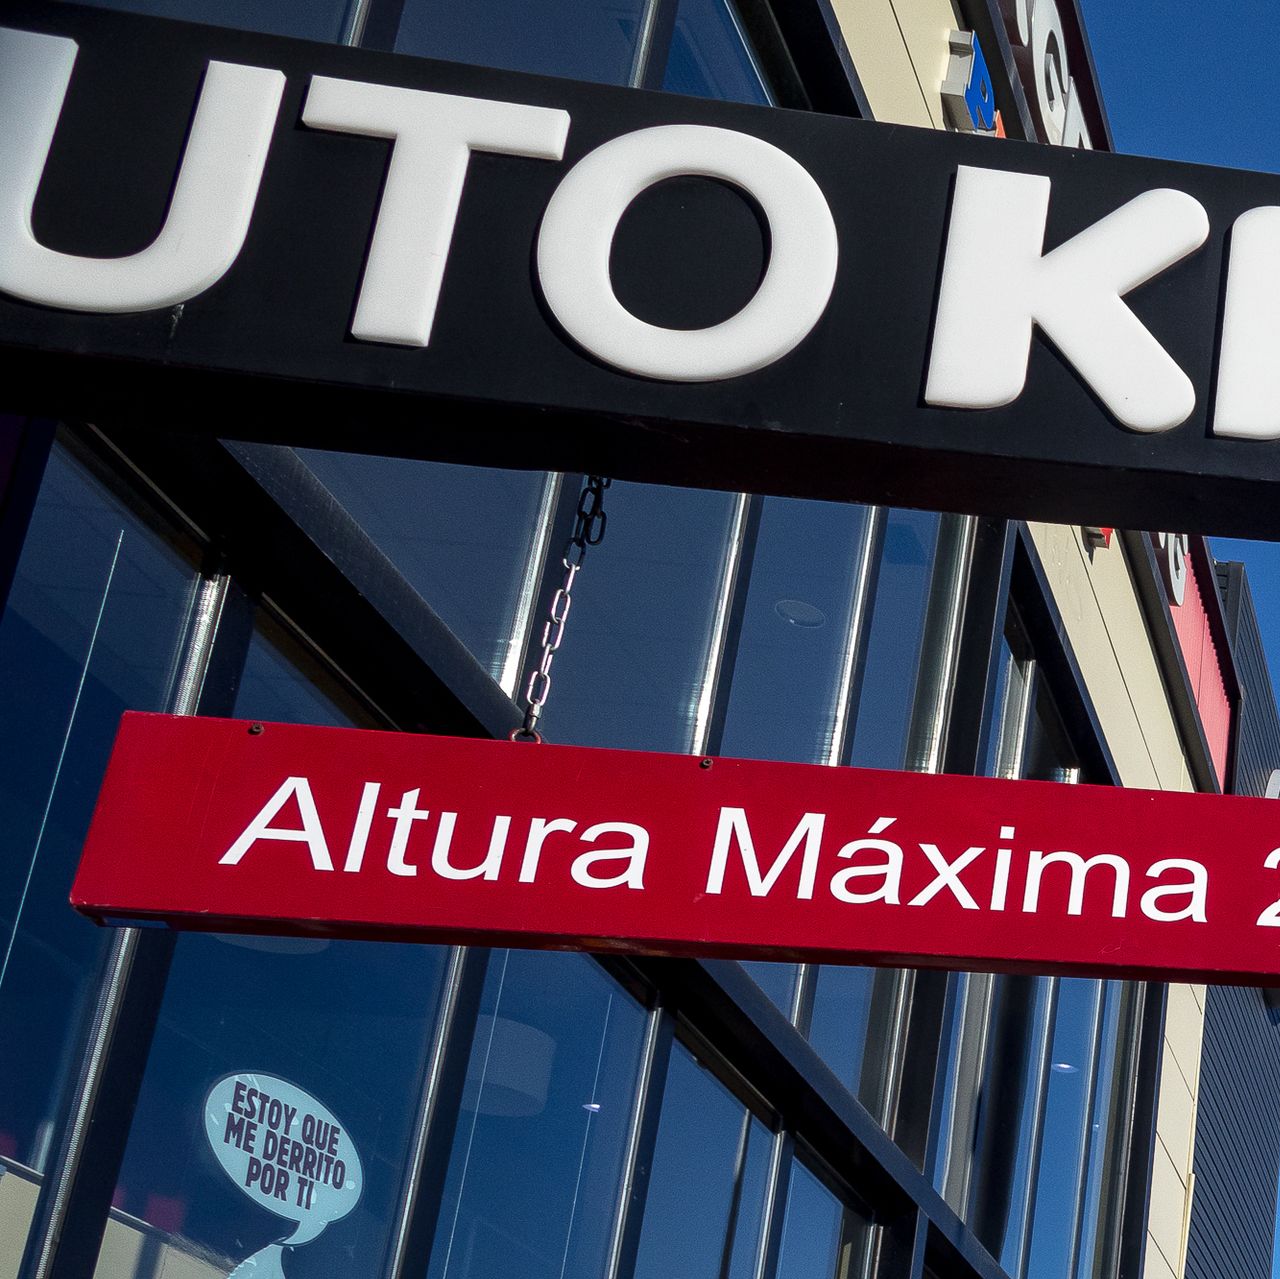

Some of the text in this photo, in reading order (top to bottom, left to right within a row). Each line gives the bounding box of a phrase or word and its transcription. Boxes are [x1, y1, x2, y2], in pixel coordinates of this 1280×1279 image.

[219, 775, 651, 891] Altura
[705, 808, 1210, 925] Máxima
[224, 1112, 346, 1190] ME DERRITO
[232, 1081, 340, 1166] ESTOY QUE
[245, 1156, 314, 1211] POR TI
